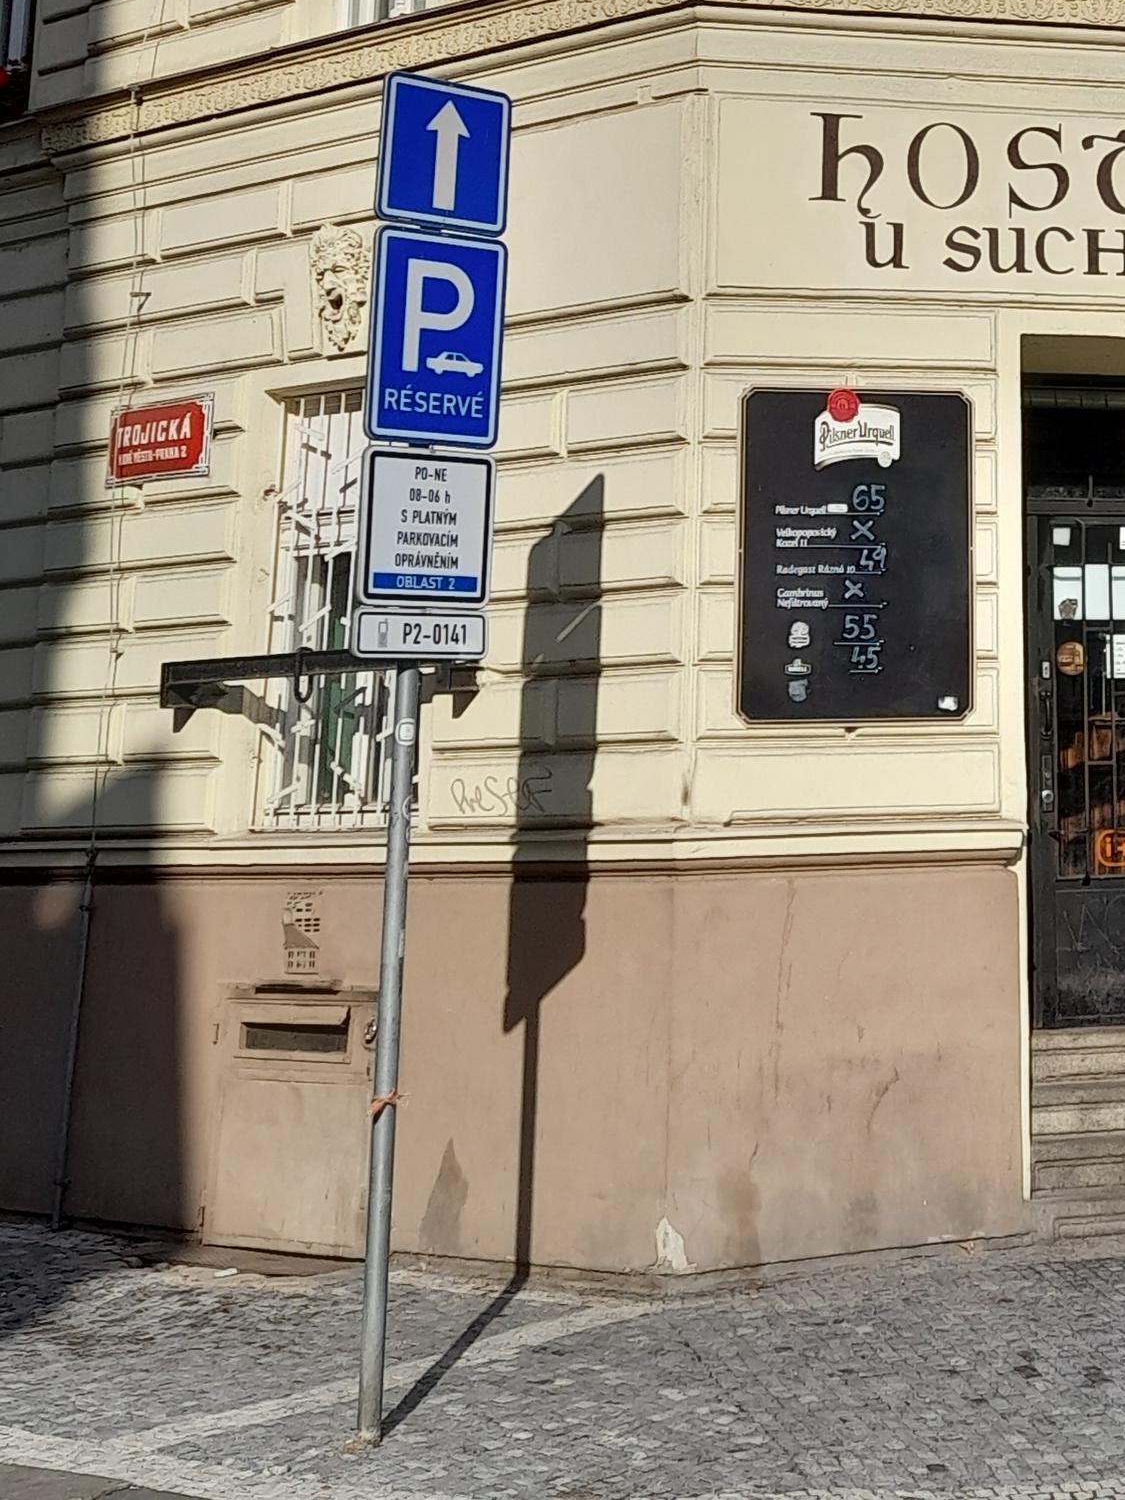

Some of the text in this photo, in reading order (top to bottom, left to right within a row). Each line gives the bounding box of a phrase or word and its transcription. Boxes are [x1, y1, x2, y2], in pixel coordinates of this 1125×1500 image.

[401, 257, 475, 372] P
[383, 383, 485, 418] RÉSERVÉ
[117, 411, 192, 449] TROJICKÁ
[819, 420, 895, 452] Pilsner Urquell
[415, 466, 448, 482] PO-NE
[409, 488, 451, 504] 08-06 h
[853, 484, 886, 511] 65
[401, 509, 458, 526] S PLATNÝM
[397, 531, 459, 547] PARKOVACÍM
[395, 551, 459, 570] OPRÁVNĚNÍM
[396, 576, 456, 590] OBLAST 2
[403, 623, 467, 646] P2-0141
[843, 614, 878, 640] 55
